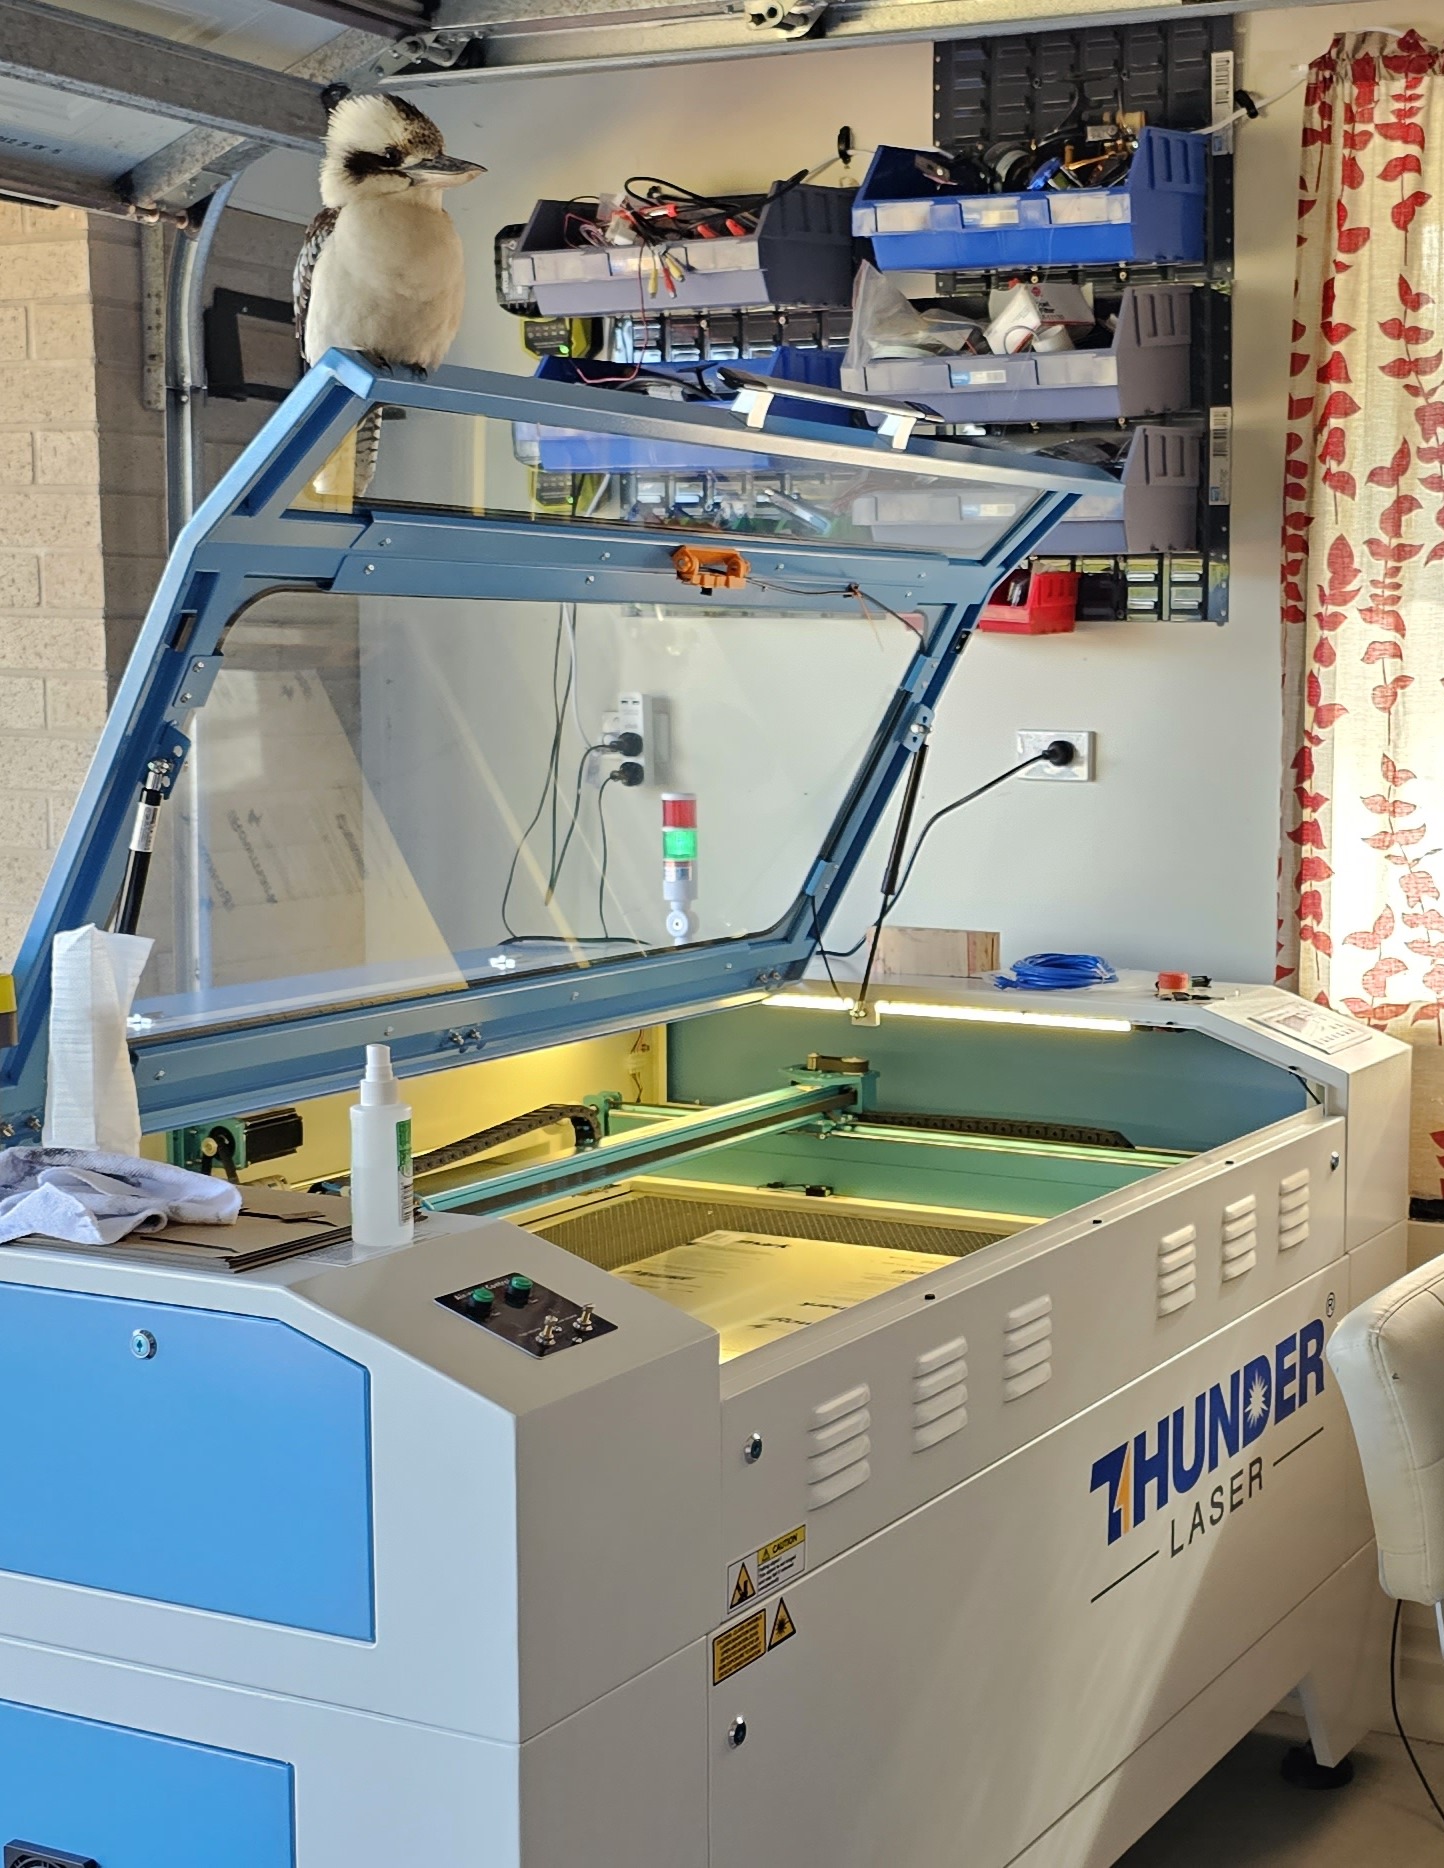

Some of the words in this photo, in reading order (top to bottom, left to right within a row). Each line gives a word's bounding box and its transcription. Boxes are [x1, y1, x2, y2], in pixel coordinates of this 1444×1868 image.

[1090, 1318, 1325, 1546] THUNDER
[772, 1533, 798, 1554] CAUTION
[1170, 1456, 1263, 1558] LASER
